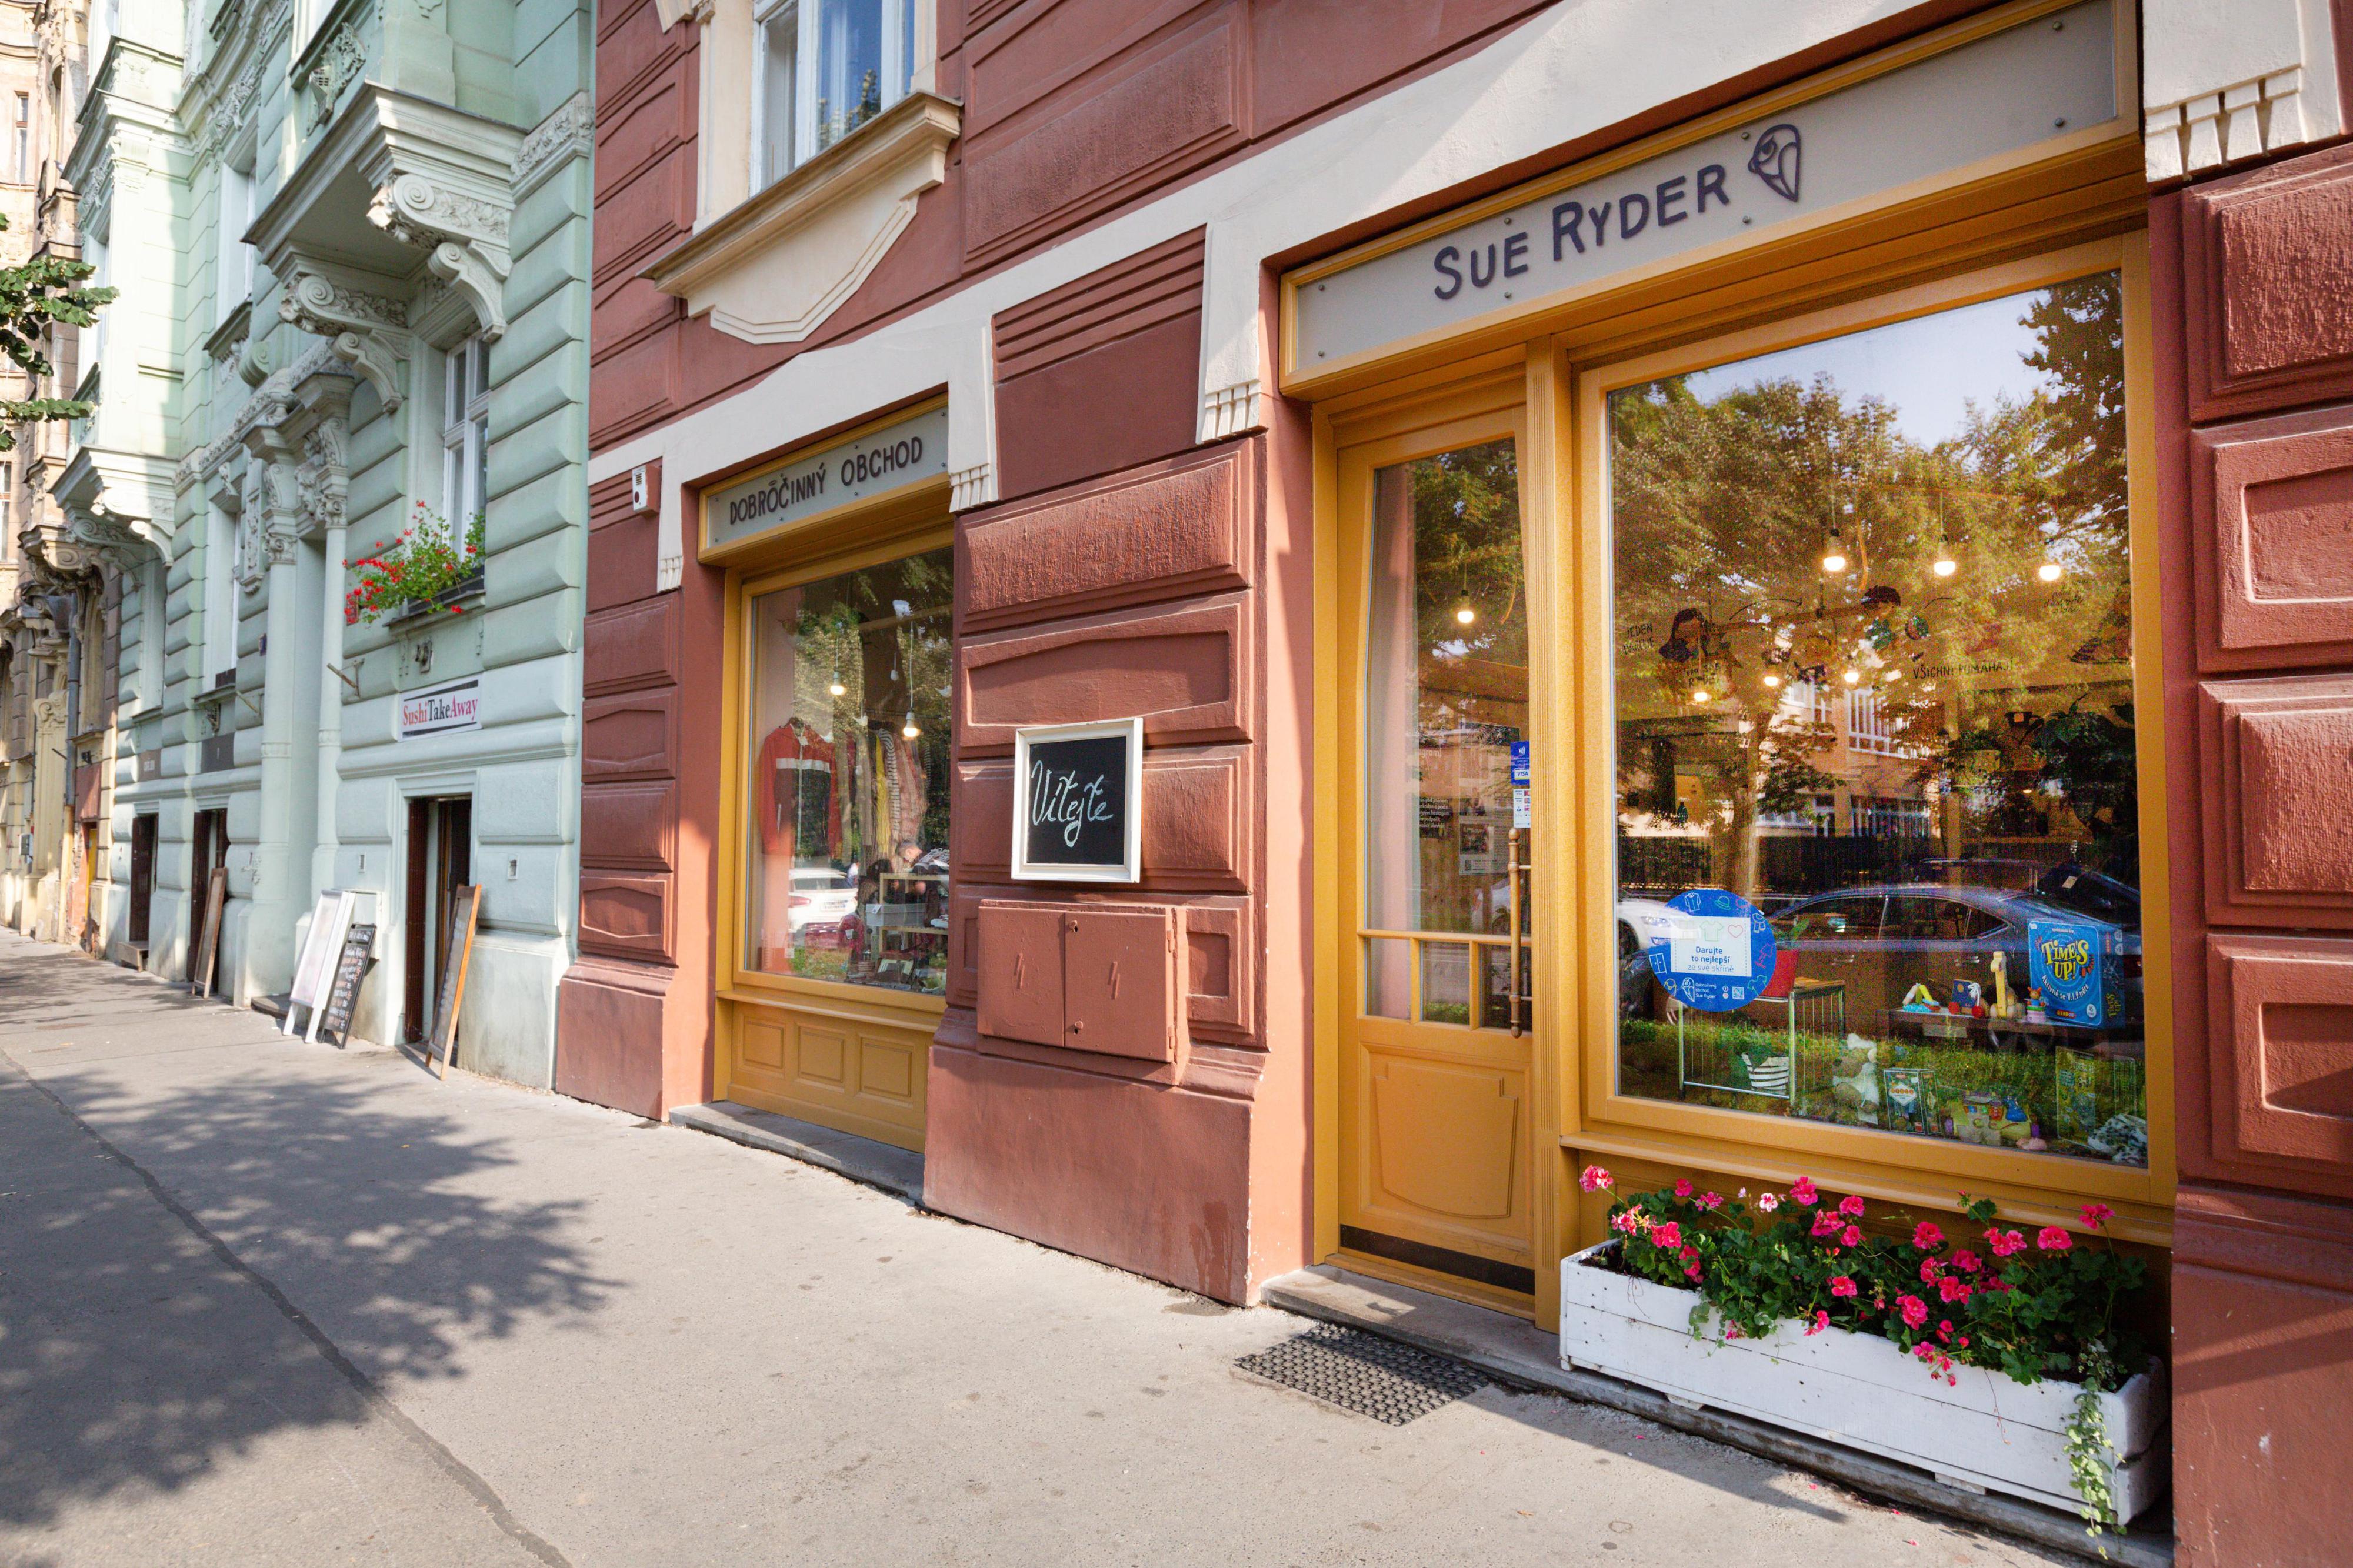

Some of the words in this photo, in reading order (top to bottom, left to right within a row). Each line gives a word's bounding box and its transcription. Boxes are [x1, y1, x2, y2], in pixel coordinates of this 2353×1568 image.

[1434, 232, 1528, 300] SUE
[1552, 164, 1730, 261] RYDER
[730, 462, 826, 525] DOBROČINNÝ
[841, 436, 923, 486] OBCHOD
[1696, 946, 1722, 955] Darujte
[1701, 956, 1730, 964] nejlepší
[2054, 961, 2077, 980] UP!
